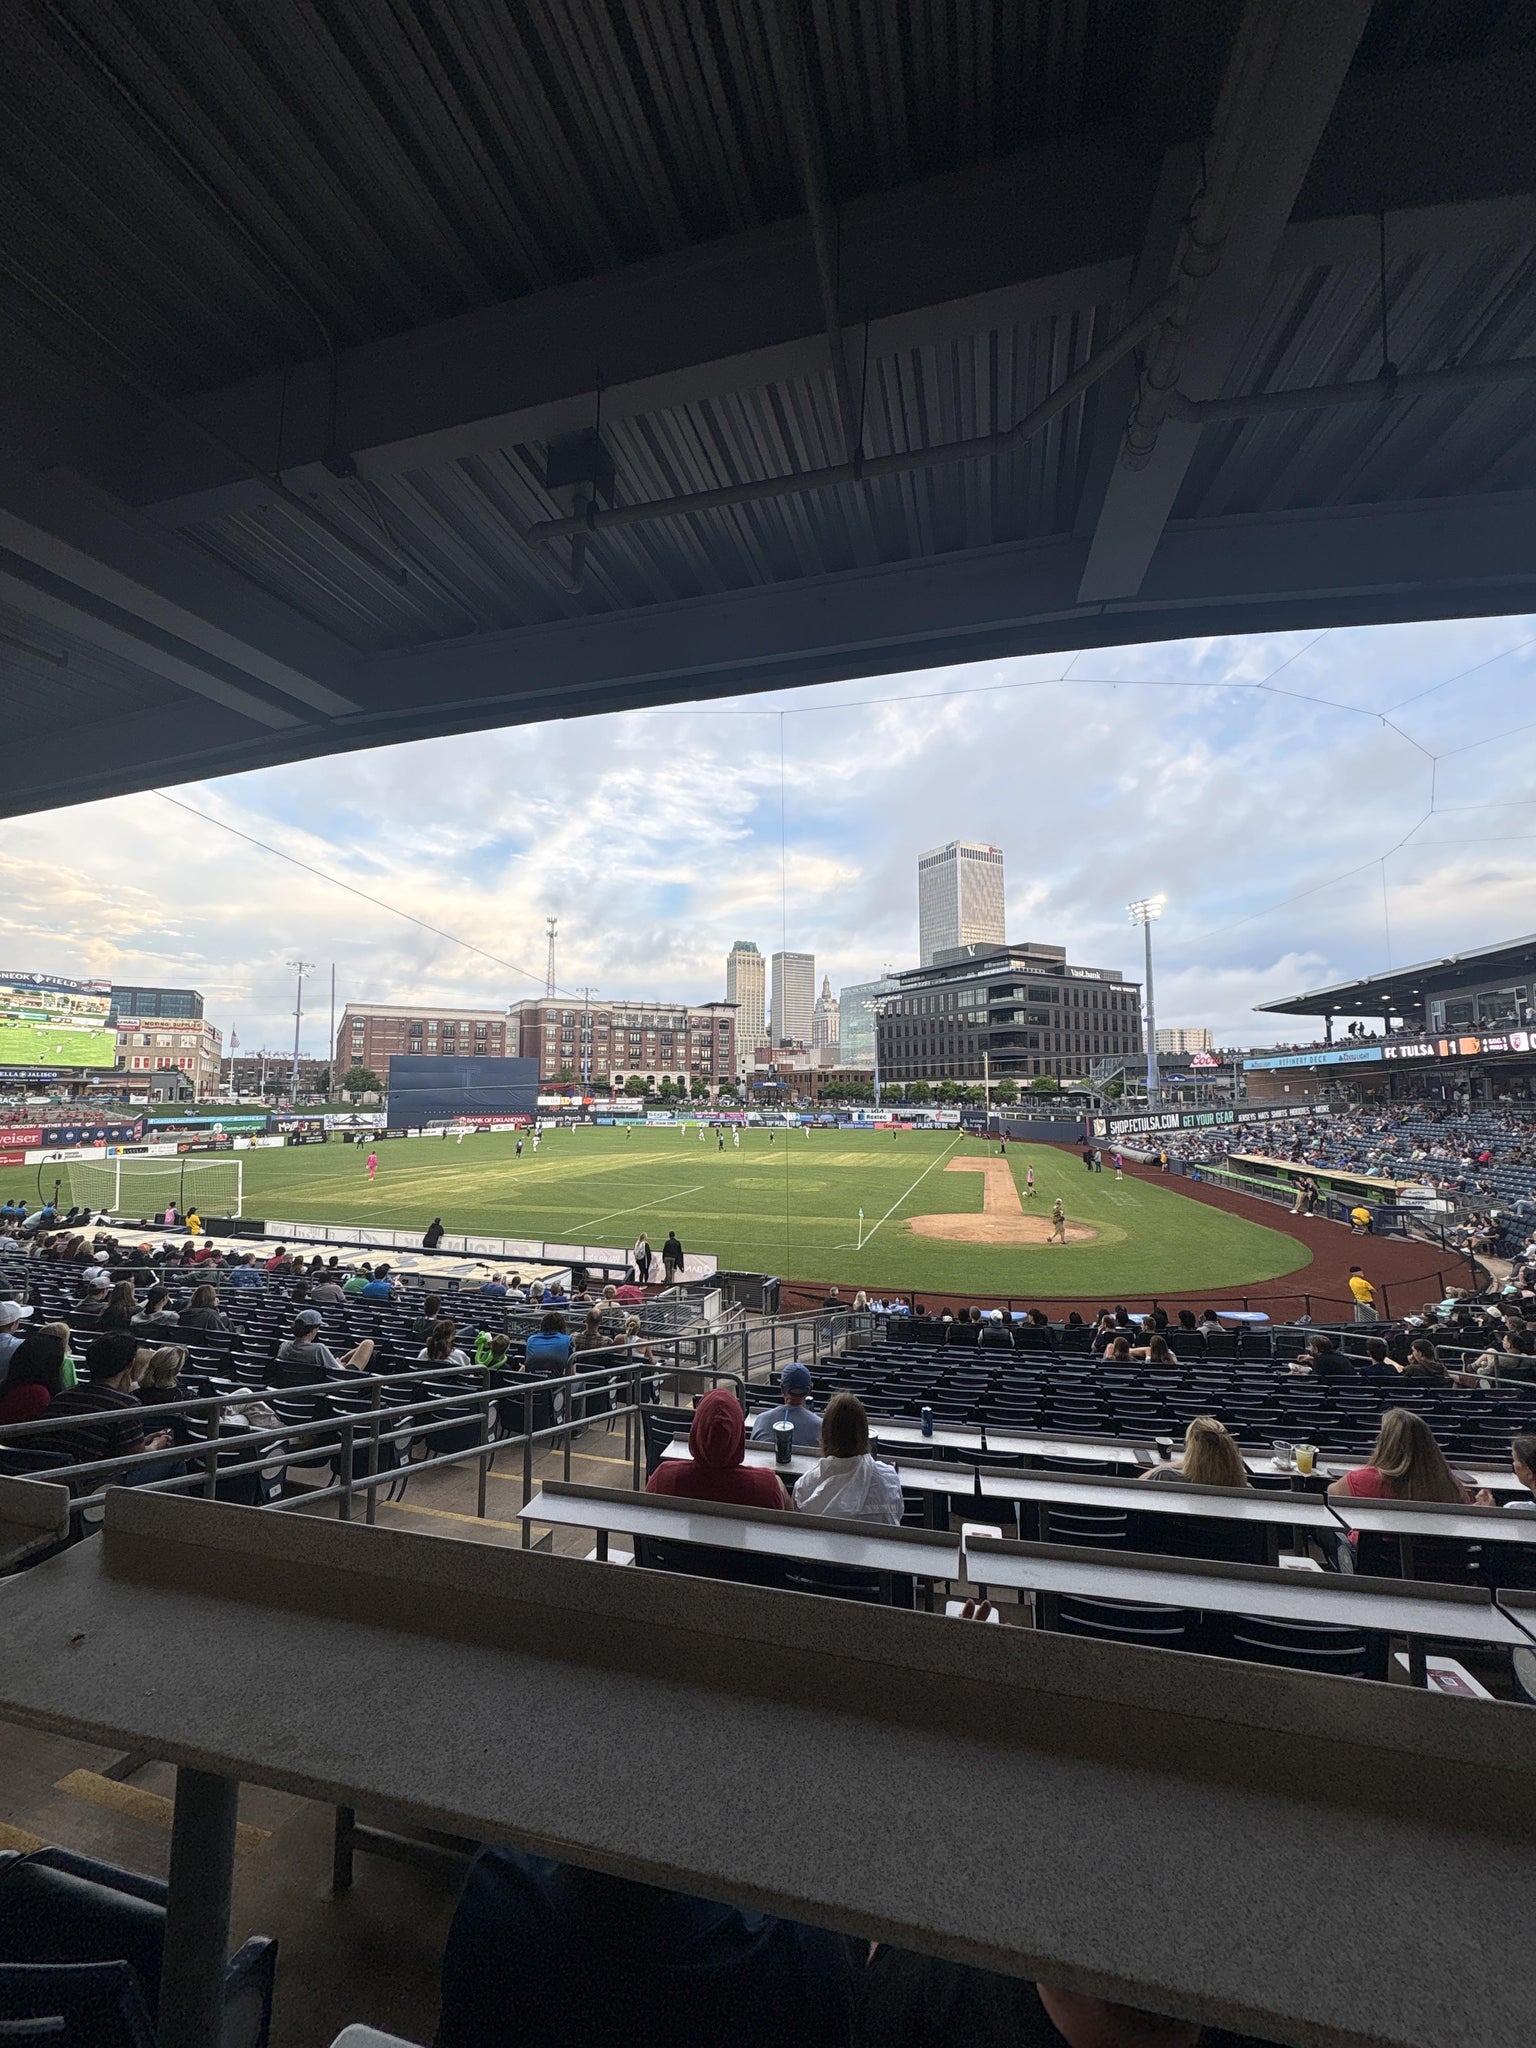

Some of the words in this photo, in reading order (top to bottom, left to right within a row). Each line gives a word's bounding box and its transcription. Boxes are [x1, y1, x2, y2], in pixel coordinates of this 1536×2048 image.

[0, 972, 30, 980] NEOK
[45, 976, 78, 988] FIELD
[1385, 1047, 1397, 1058] FC
[1399, 1044, 1435, 1058] TULSA
[1449, 1041, 1457, 1054] 1
[1192, 1054, 1223, 1066] Coors
[1279, 1057, 1307, 1066] REFINERY
[1309, 1055, 1327, 1064] DECK
[1110, 1114, 1180, 1135] SHOP.FCTULSA.COM
[1183, 1115, 1195, 1127] GET
[1196, 1113, 1215, 1126] YOUR
[1215, 1111, 1234, 1124] GEAR
[1238, 1113, 1257, 1122] JERSEYS
[1258, 1111, 1270, 1120] HATS
[1271, 1109, 1288, 1119] SHIRTS
[1289, 1107, 1310, 1116] HOODIES
